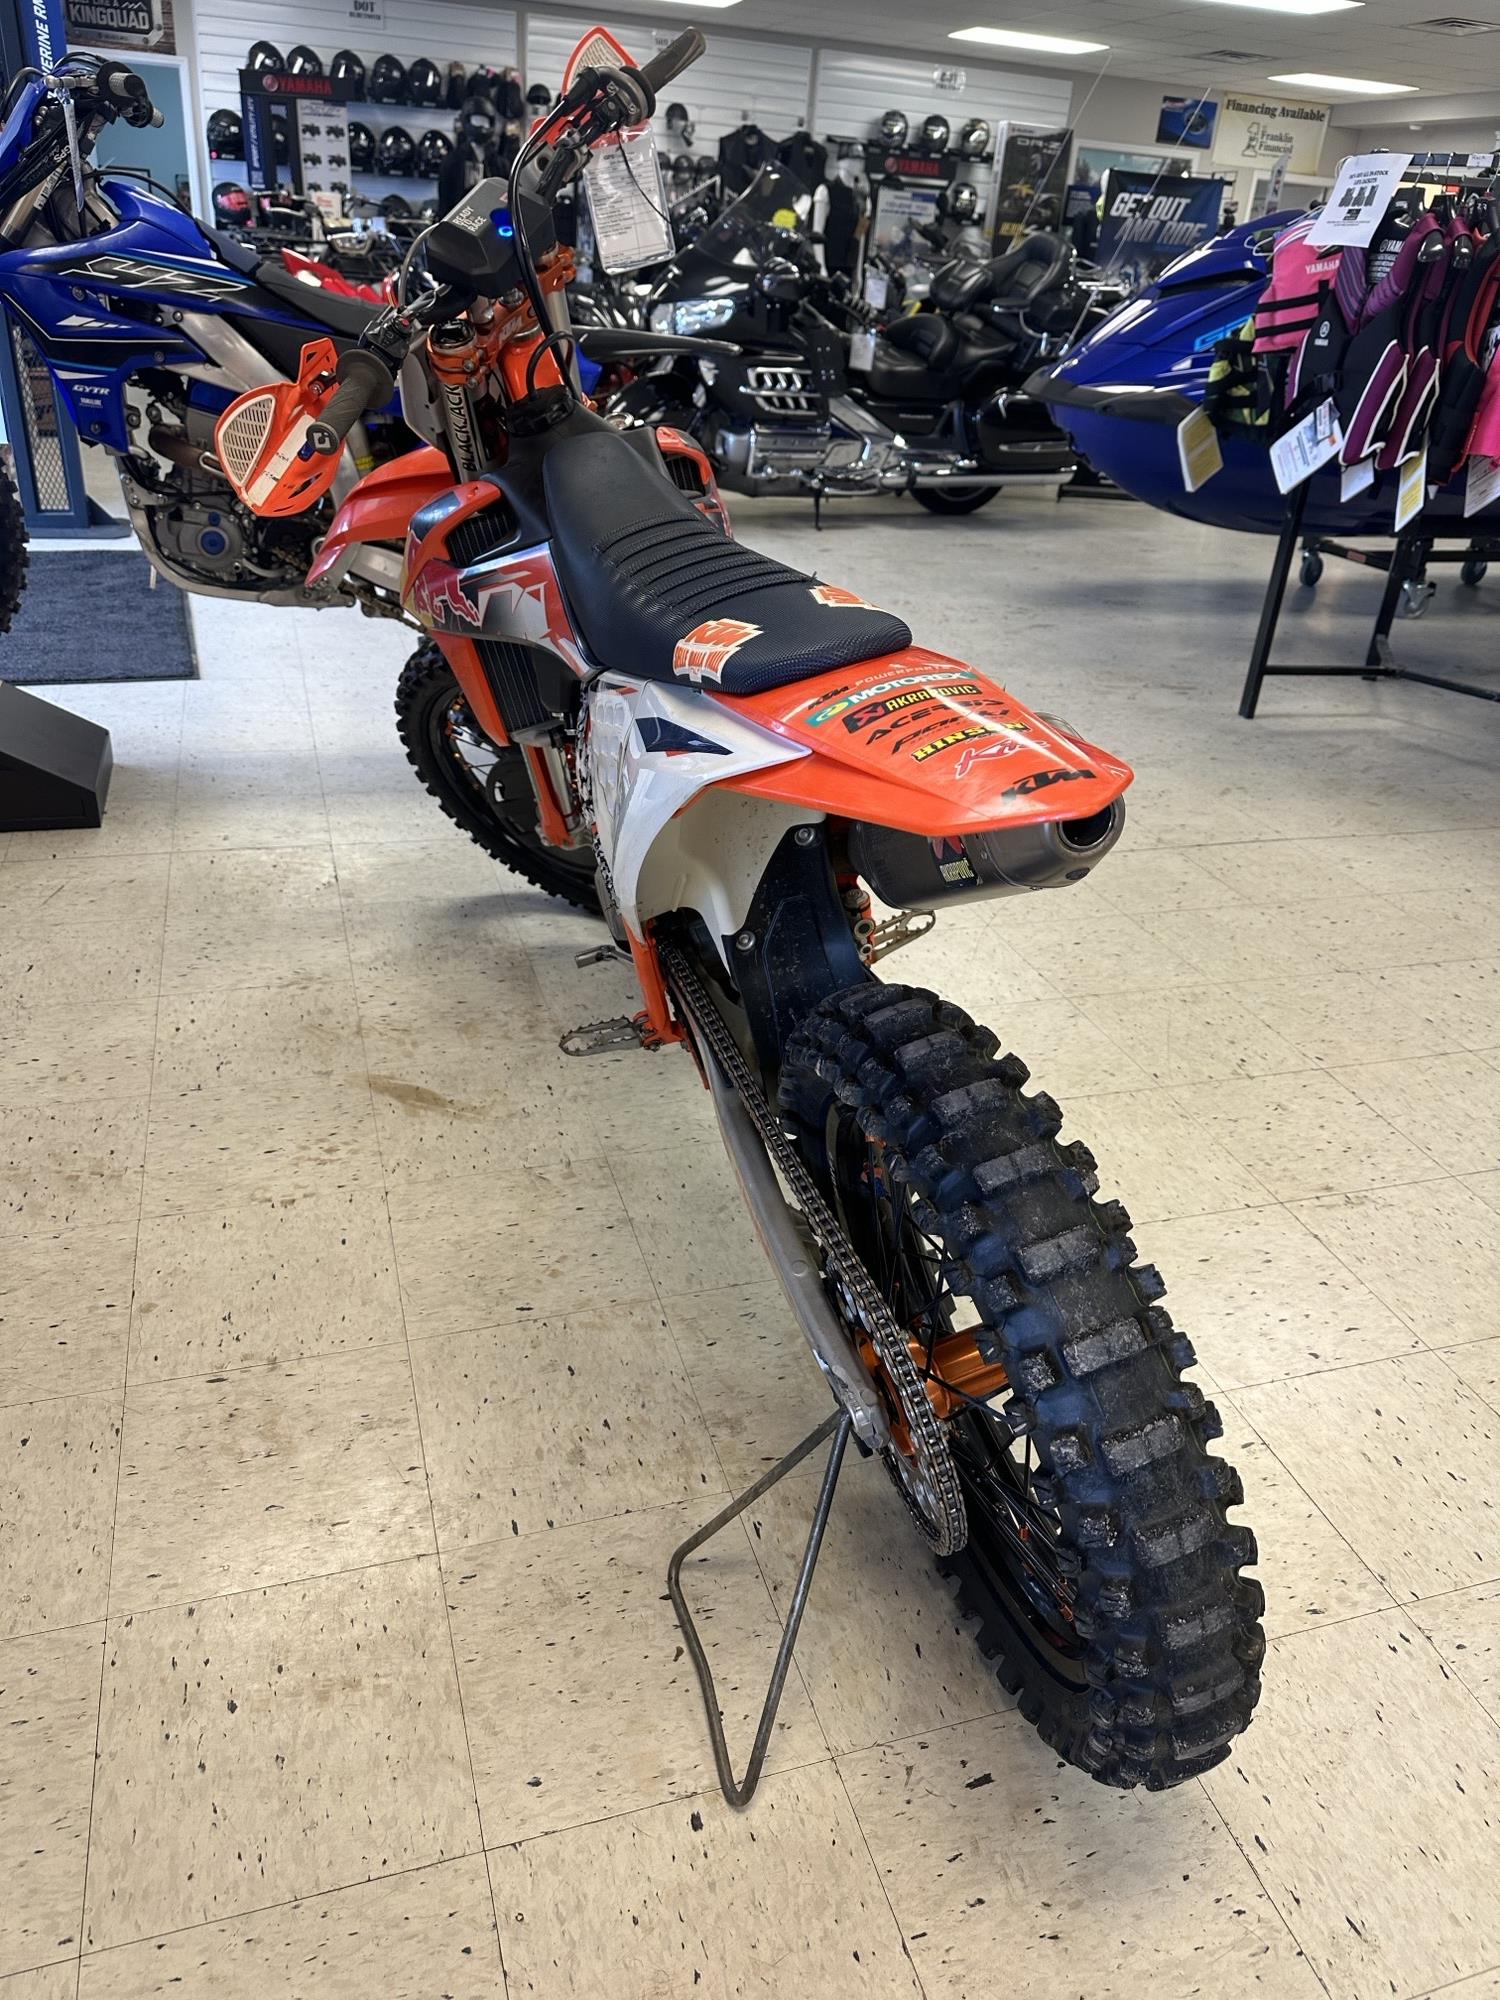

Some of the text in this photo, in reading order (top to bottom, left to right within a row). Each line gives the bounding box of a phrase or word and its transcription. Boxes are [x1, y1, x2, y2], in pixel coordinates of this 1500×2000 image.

[69, 3, 150, 30] KINGQUAD
[278, 77, 333, 96] YAMAHA
[1226, 99, 1325, 121] Financing Available
[452, 206, 474, 225] READY
[1109, 192, 1154, 217] GET
[1148, 196, 1191, 221] OUT
[468, 216, 487, 232] RACE
[1114, 217, 1208, 246] AND RIDE
[1305, 259, 1340, 275] YAMAHA
[72, 384, 110, 396] GYTR
[444, 384, 478, 472] BLACKJACK
[808, 686, 849, 710] KTM
[847, 671, 962, 704] MOTOREX
[1001, 768, 1097, 801] KTM
